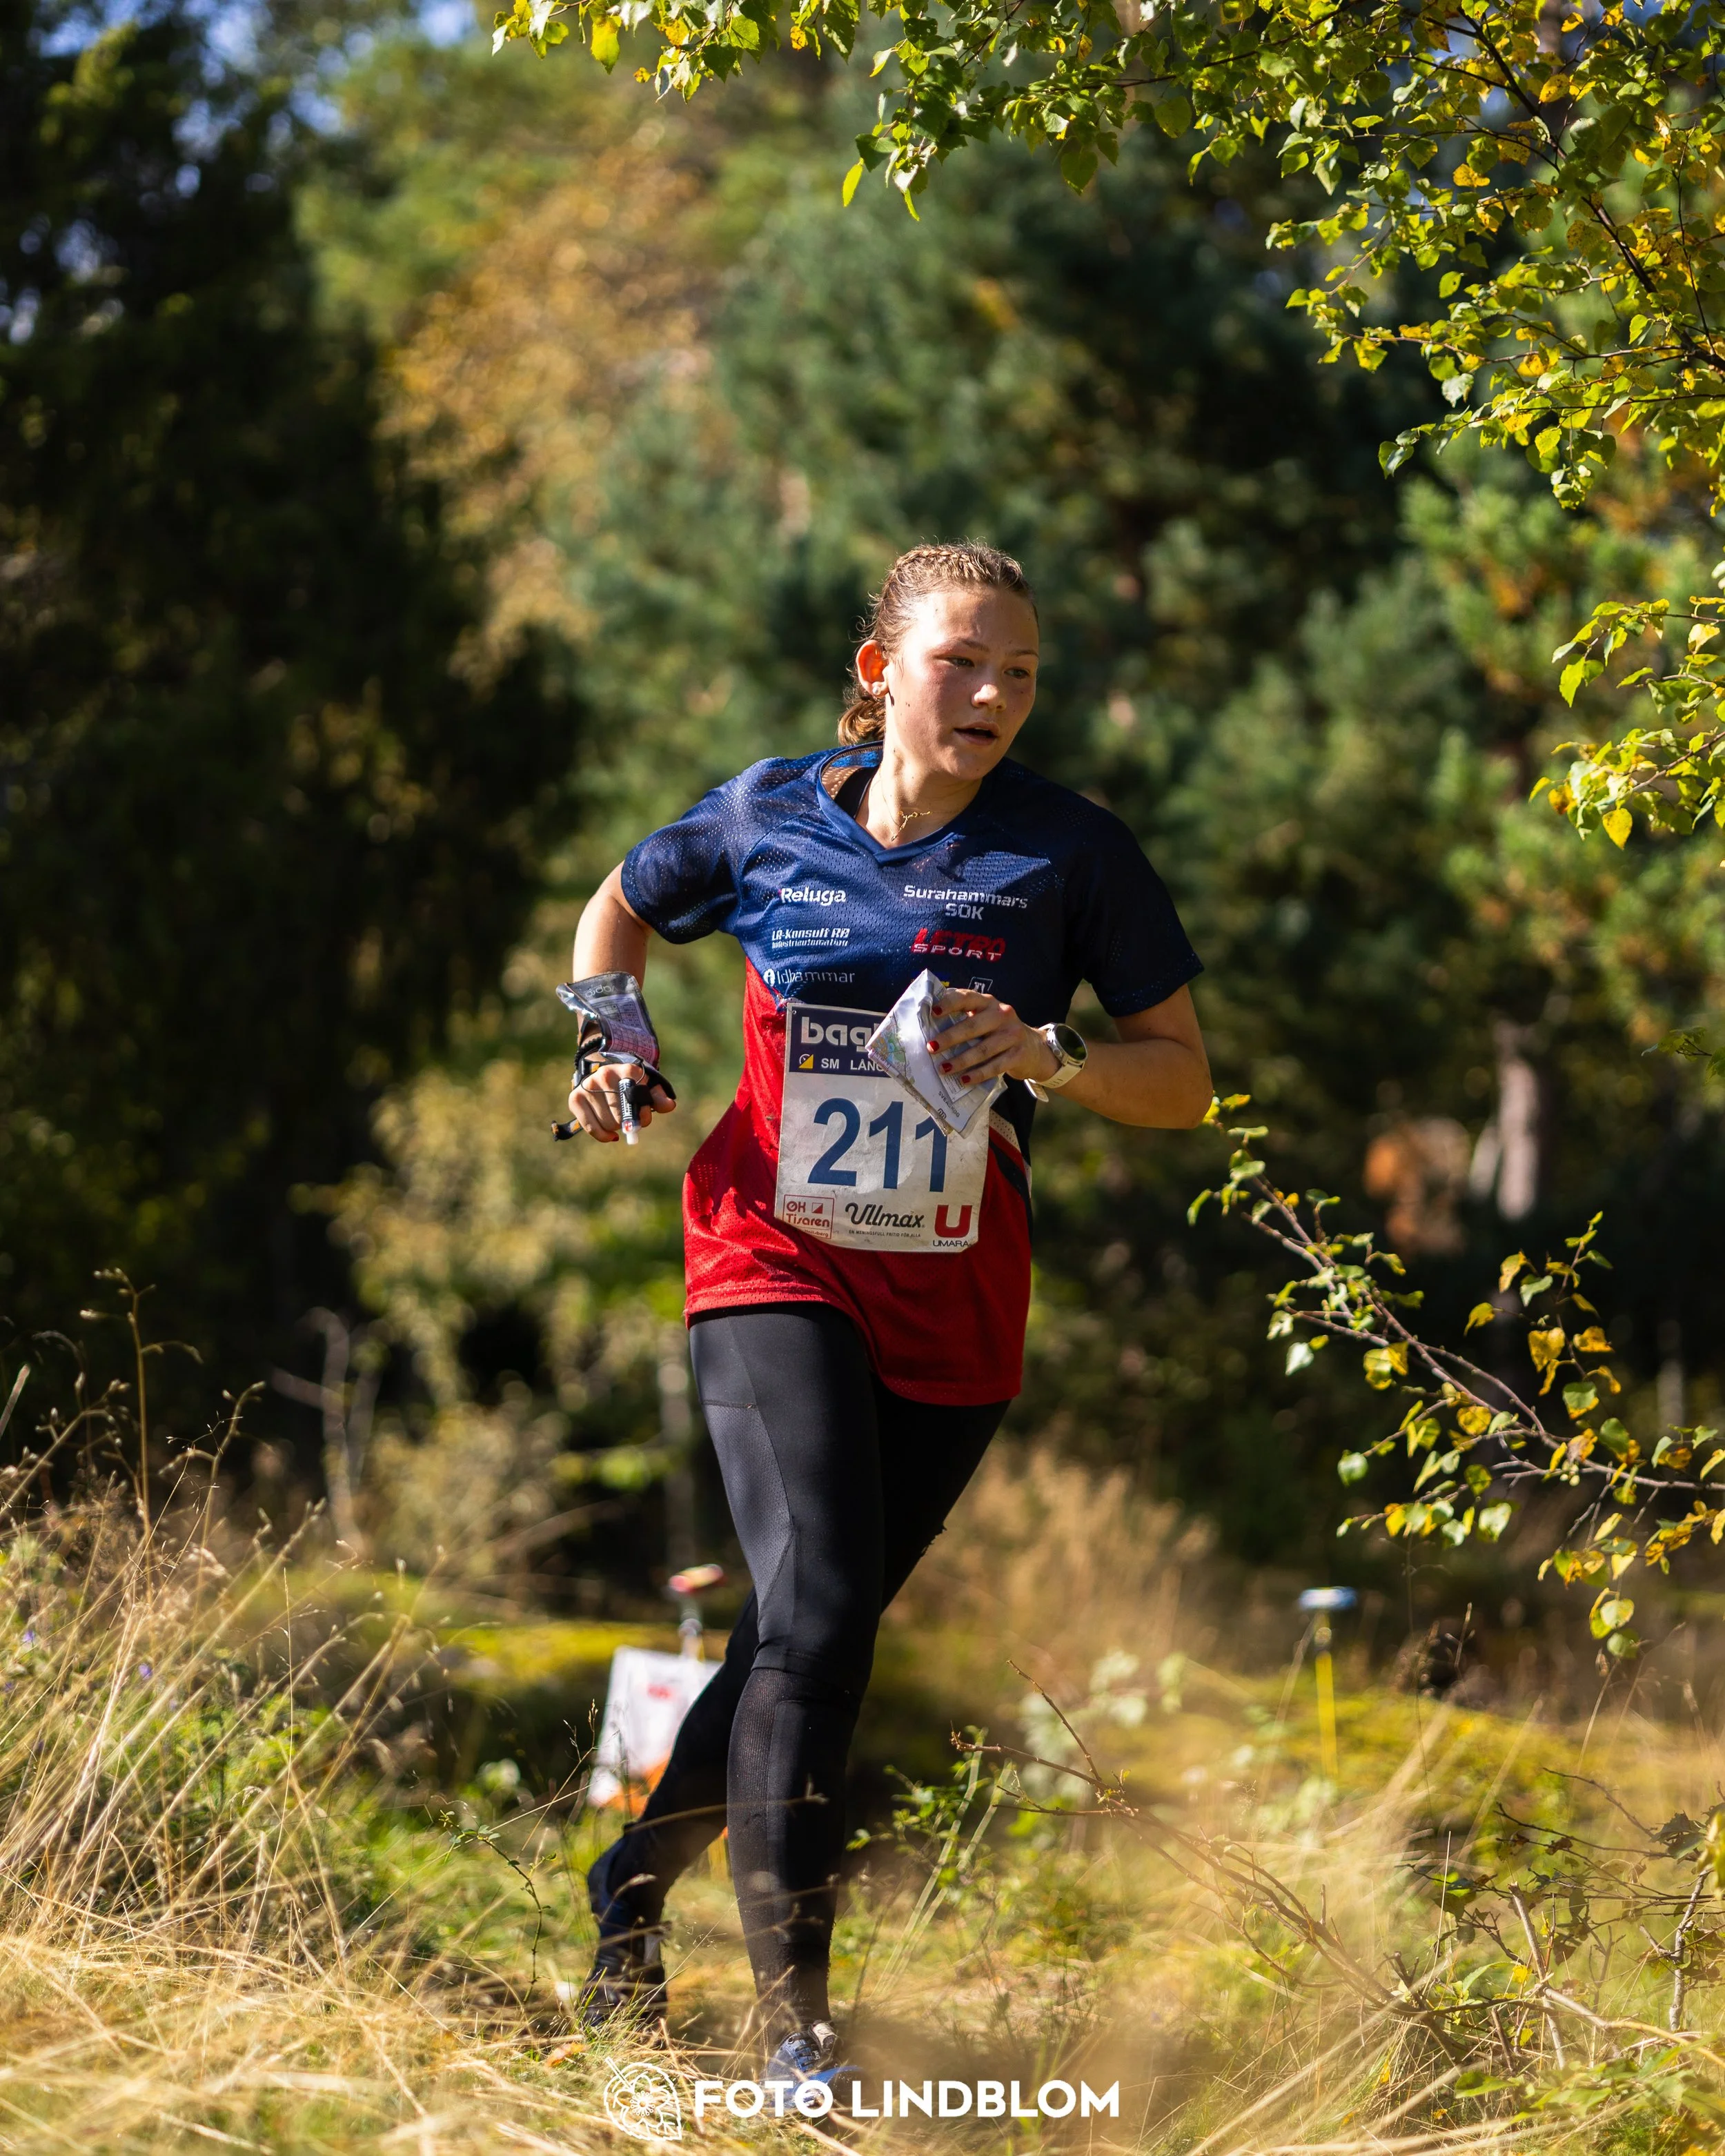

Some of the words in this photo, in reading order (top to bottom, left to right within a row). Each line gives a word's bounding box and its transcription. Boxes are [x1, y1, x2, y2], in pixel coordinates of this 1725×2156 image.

[780, 886, 847, 907] Reluga
[904, 885, 1028, 909] Surahammars
[945, 902, 985, 920] SOK
[772, 938, 849, 949] Industriautomation
[914, 943, 1002, 961] SPORT
[801, 1016, 880, 1052] bag
[821, 1058, 840, 1069] SM
[807, 1098, 947, 1192] 211
[786, 1214, 830, 1227] Tisaren
[845, 1203, 925, 1228] Ullmax
